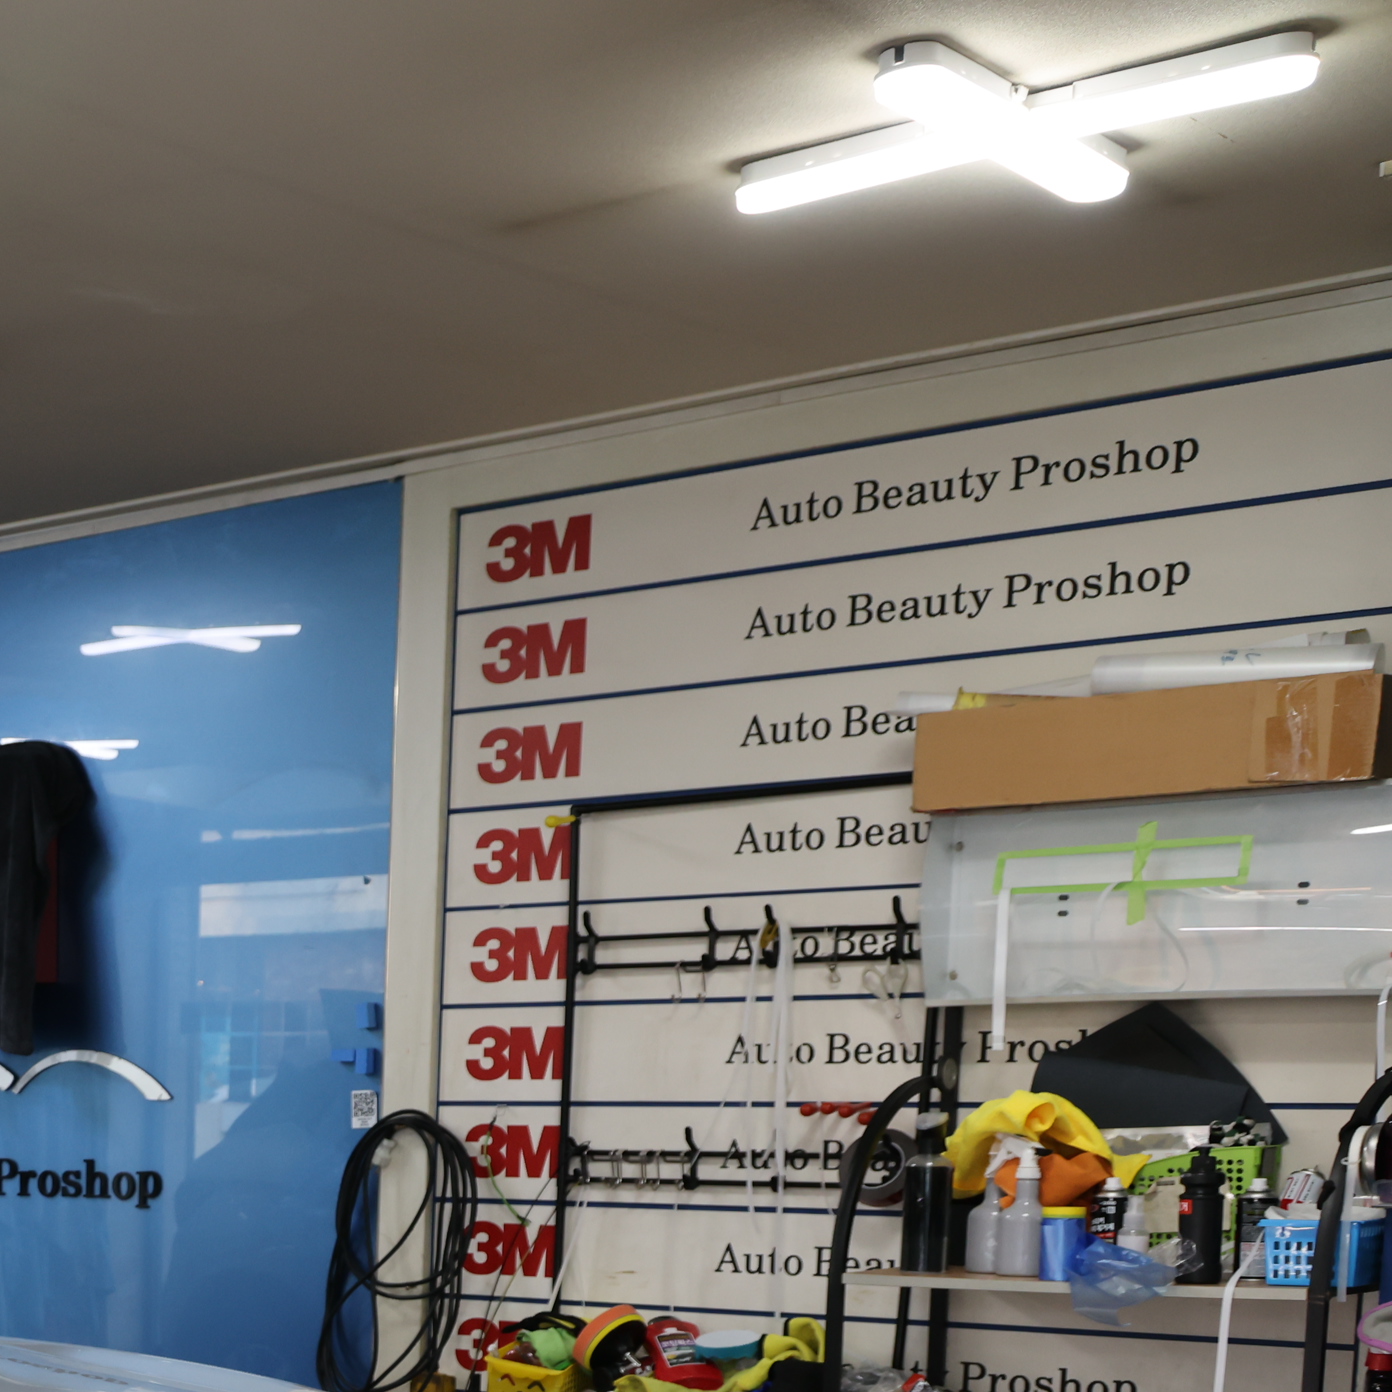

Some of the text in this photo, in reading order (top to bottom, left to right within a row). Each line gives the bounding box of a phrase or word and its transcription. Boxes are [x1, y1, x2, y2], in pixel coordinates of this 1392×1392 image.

[750, 436, 1200, 532] Auto Beauty Proshop
[486, 514, 592, 583] 3M
[744, 559, 1191, 640] Auto Beauty Proshop
[481, 617, 587, 684] 3M
[477, 721, 583, 784] 3M
[740, 704, 916, 747] Auto Bea
[473, 824, 571, 884] 3M
[734, 815, 932, 855] Auto Beau
[470, 925, 569, 983] 3M
[466, 1026, 565, 1081] 3M
[465, 1124, 561, 1179] 3M
[463, 1221, 556, 1278] 3M
